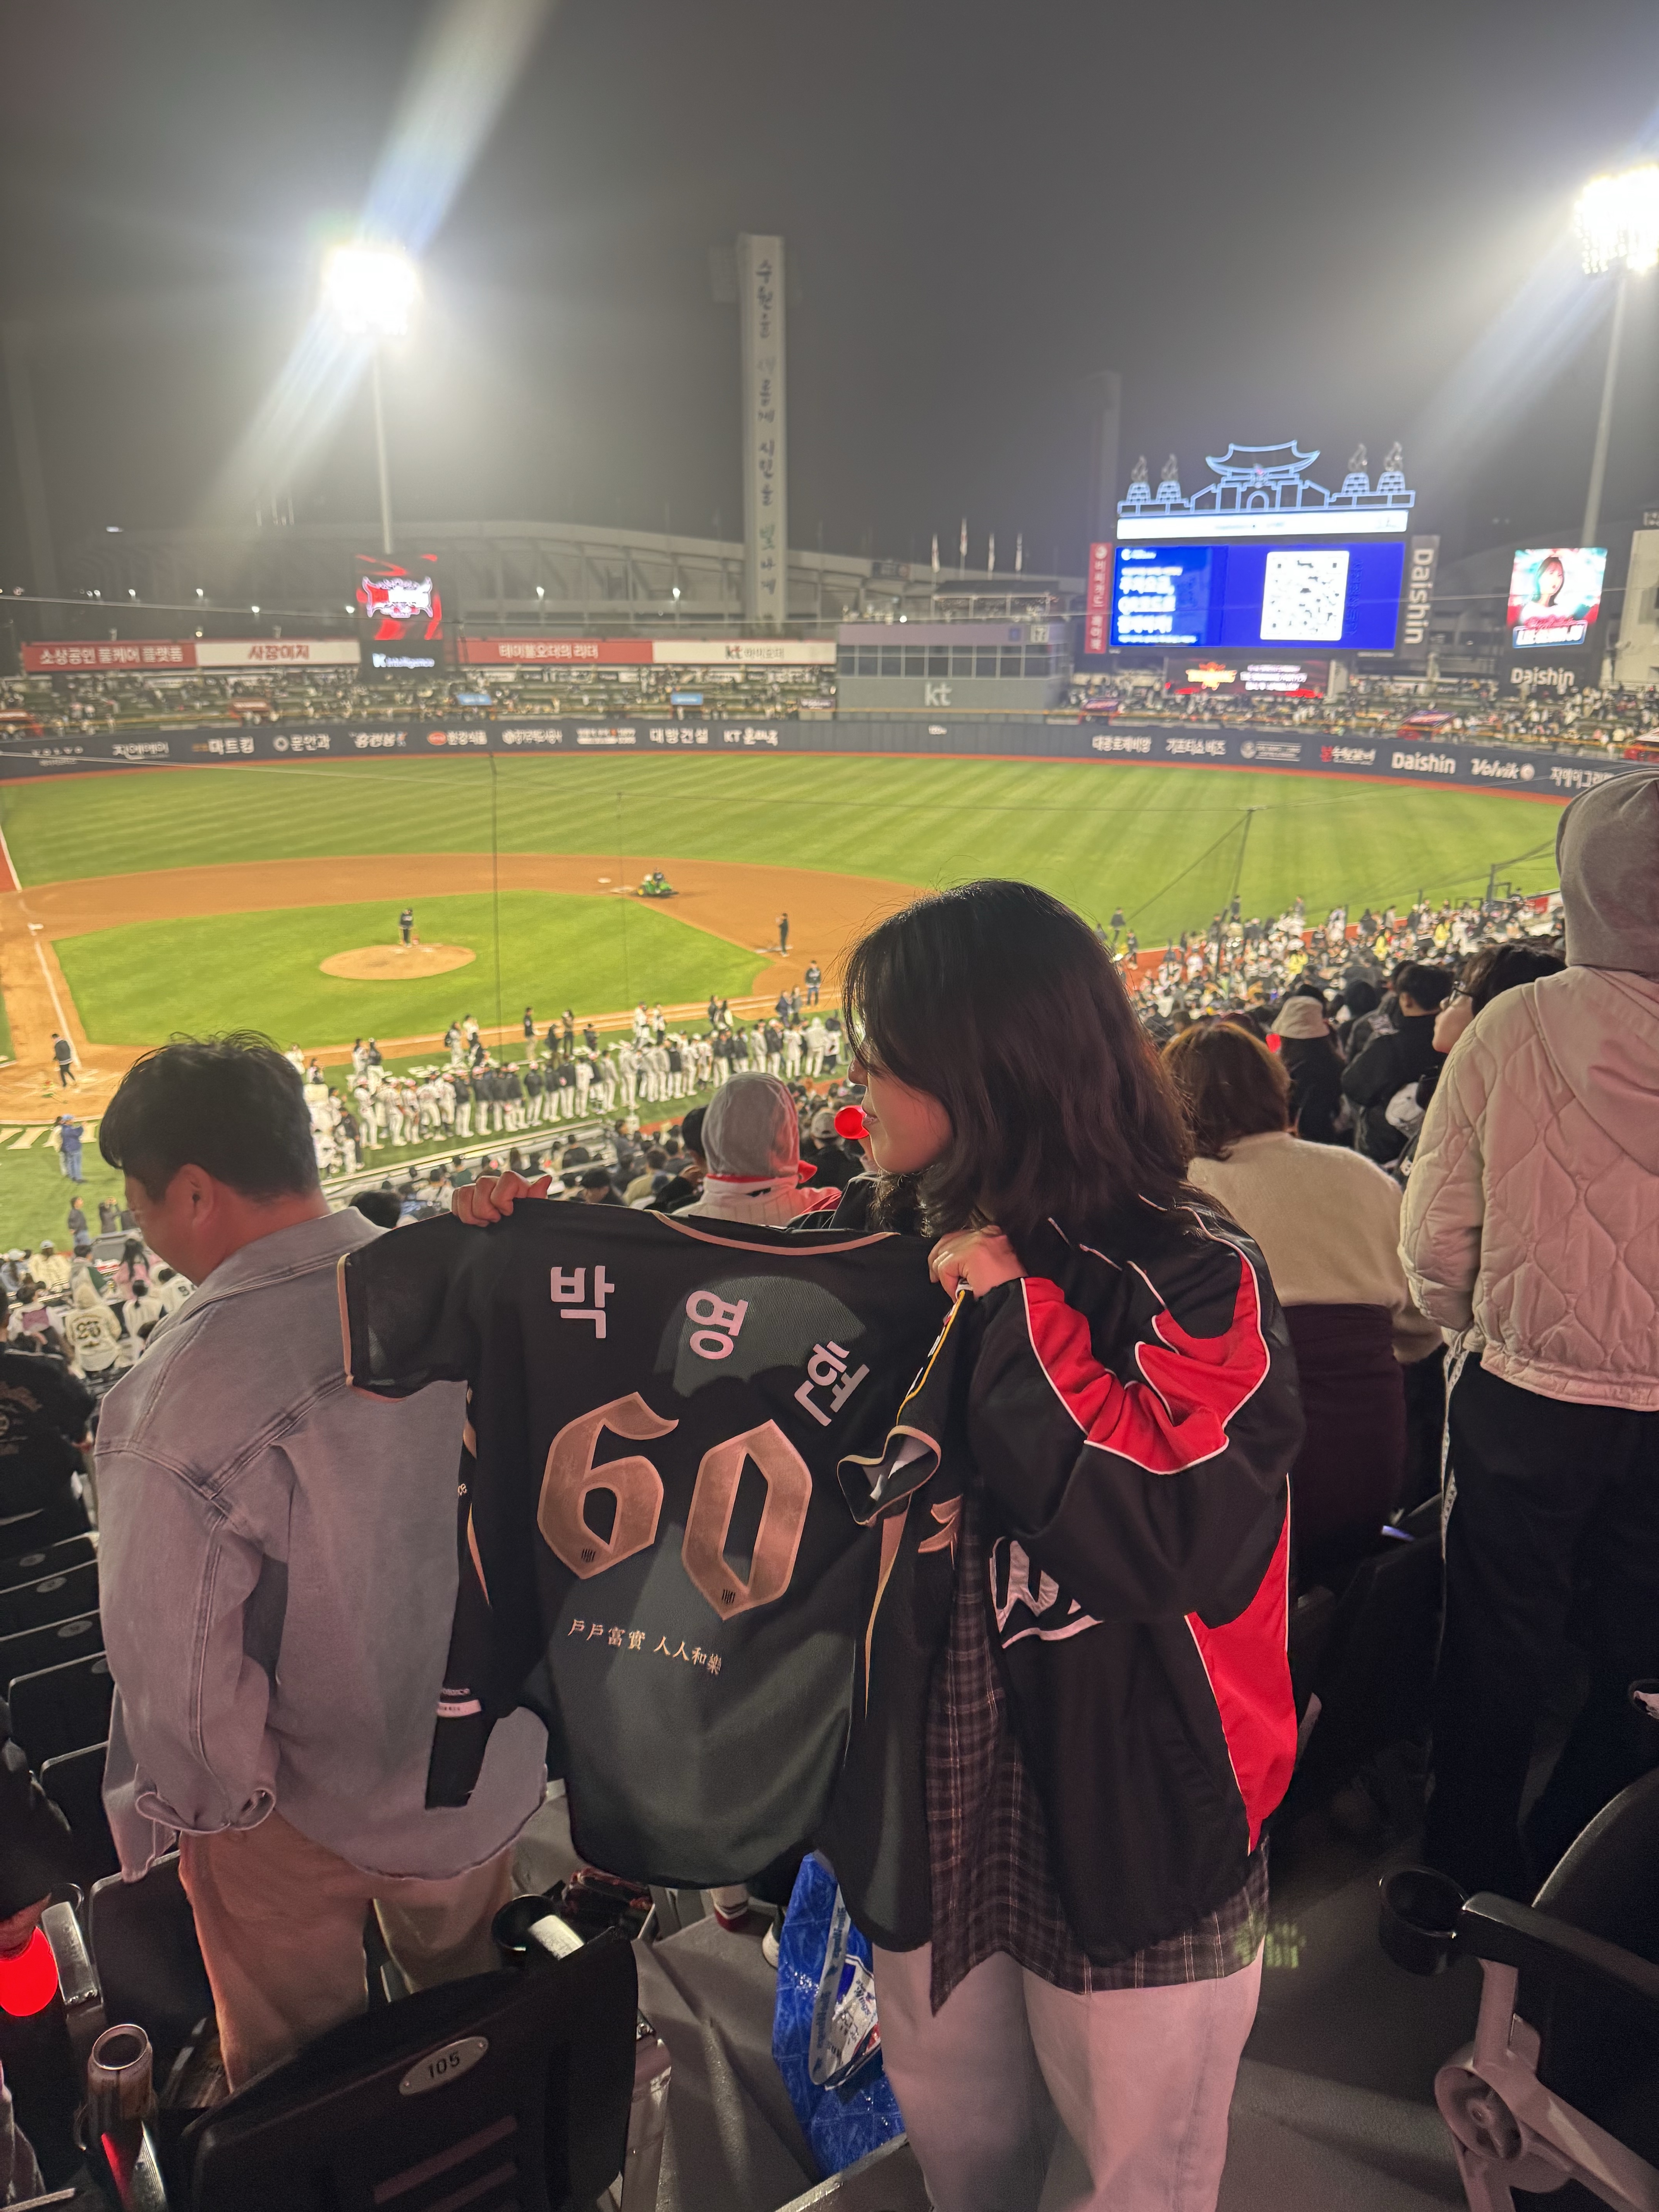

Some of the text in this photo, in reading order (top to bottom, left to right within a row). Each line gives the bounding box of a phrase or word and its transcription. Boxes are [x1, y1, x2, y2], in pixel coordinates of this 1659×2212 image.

[1404, 548, 1434, 644] Daishin
[40, 646, 96, 665] 소상공인
[248, 644, 309, 661] 사장이지
[498, 643, 598, 659] 테이블오더의 리더
[725, 645, 742, 659] kt
[1511, 666, 1575, 686] Daishin
[925, 682, 952, 707] kt
[208, 736, 255, 755] 마트킹
[724, 729, 742, 743] KT
[1392, 752, 1456, 774] Daishin
[1471, 758, 1518, 779] Volvik
[550, 1264, 870, 1427] 박영현
[537, 1391, 812, 1621] 60
[428, 2051, 460, 2078] 105
